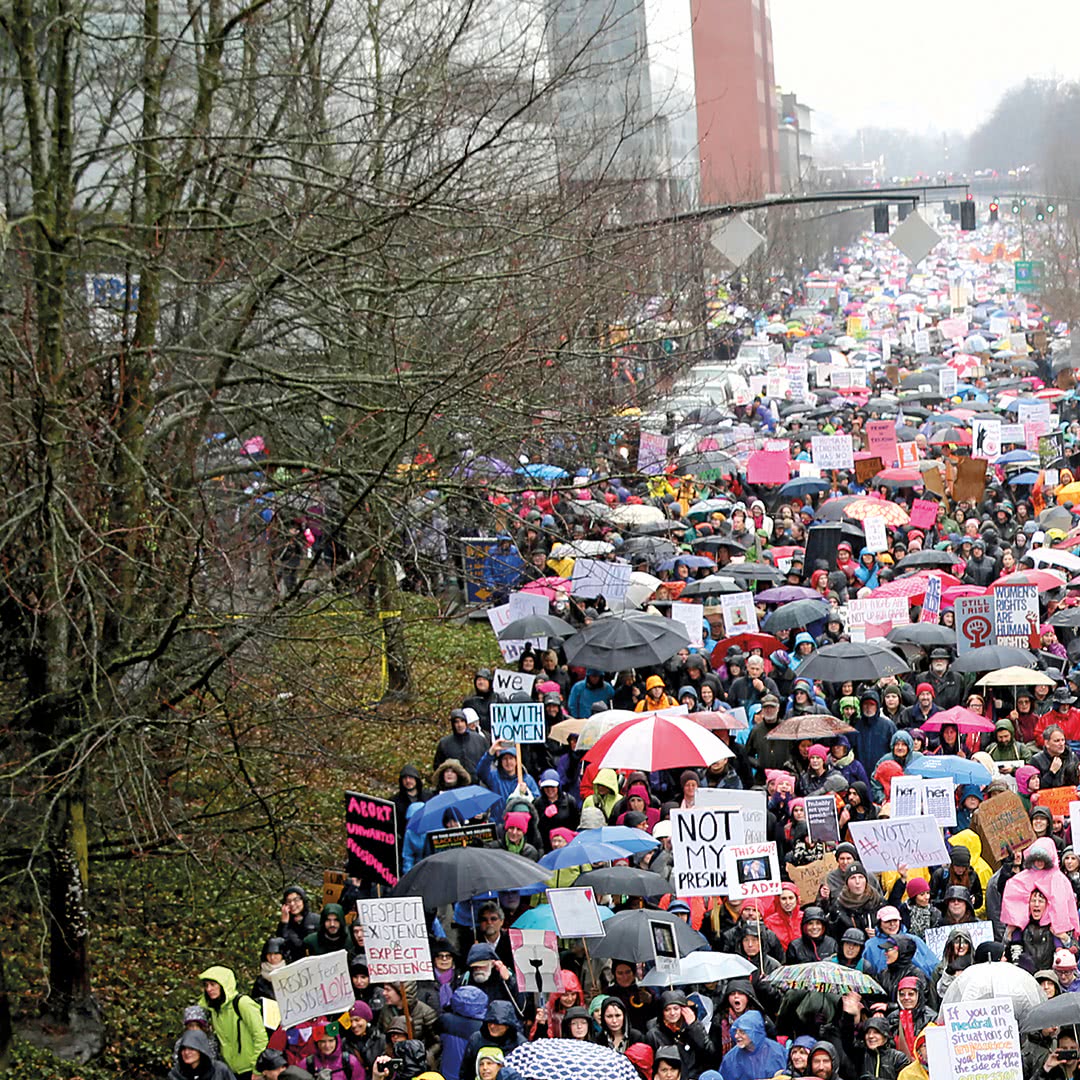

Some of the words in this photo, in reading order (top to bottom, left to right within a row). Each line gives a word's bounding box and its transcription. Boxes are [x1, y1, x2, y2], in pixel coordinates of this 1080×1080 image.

[996, 586, 1037, 599] WOMEN'S
[996, 600, 1027, 611] RIGHTS
[996, 612, 1014, 623] ARE
[996, 624, 1029, 635] HUMAN
[510, 706, 543, 722] WITH
[492, 724, 544, 741] WOMEN
[348, 797, 392, 822] ABORT
[678, 810, 740, 842] NOT
[686, 844, 726, 869] MY
[730, 847, 754, 858] THIS
[361, 902, 421, 924] RESPECT
[364, 922, 428, 940] EXISTENCE
[390, 940, 400, 950] OR
[369, 948, 424, 960] EXPECT
[368, 960, 434, 976] RESISTENCE
[284, 987, 319, 1019] ASSIST
[319, 972, 353, 1005] LOVE
[946, 1006, 960, 1020] If
[966, 1007, 988, 1022] you
[990, 1004, 1012, 1015] are
[951, 1017, 993, 1032] neutral
[994, 1016, 1006, 1027] in
[952, 1029, 1002, 1046] situations
[1004, 1026, 1014, 1040] of
[954, 1064, 970, 1074] the
[971, 1063, 990, 1072] side
[990, 1060, 1001, 1069] of
[1002, 1059, 1020, 1068] the
[956, 1055, 972, 1066] you
[976, 1051, 996, 1062] have
